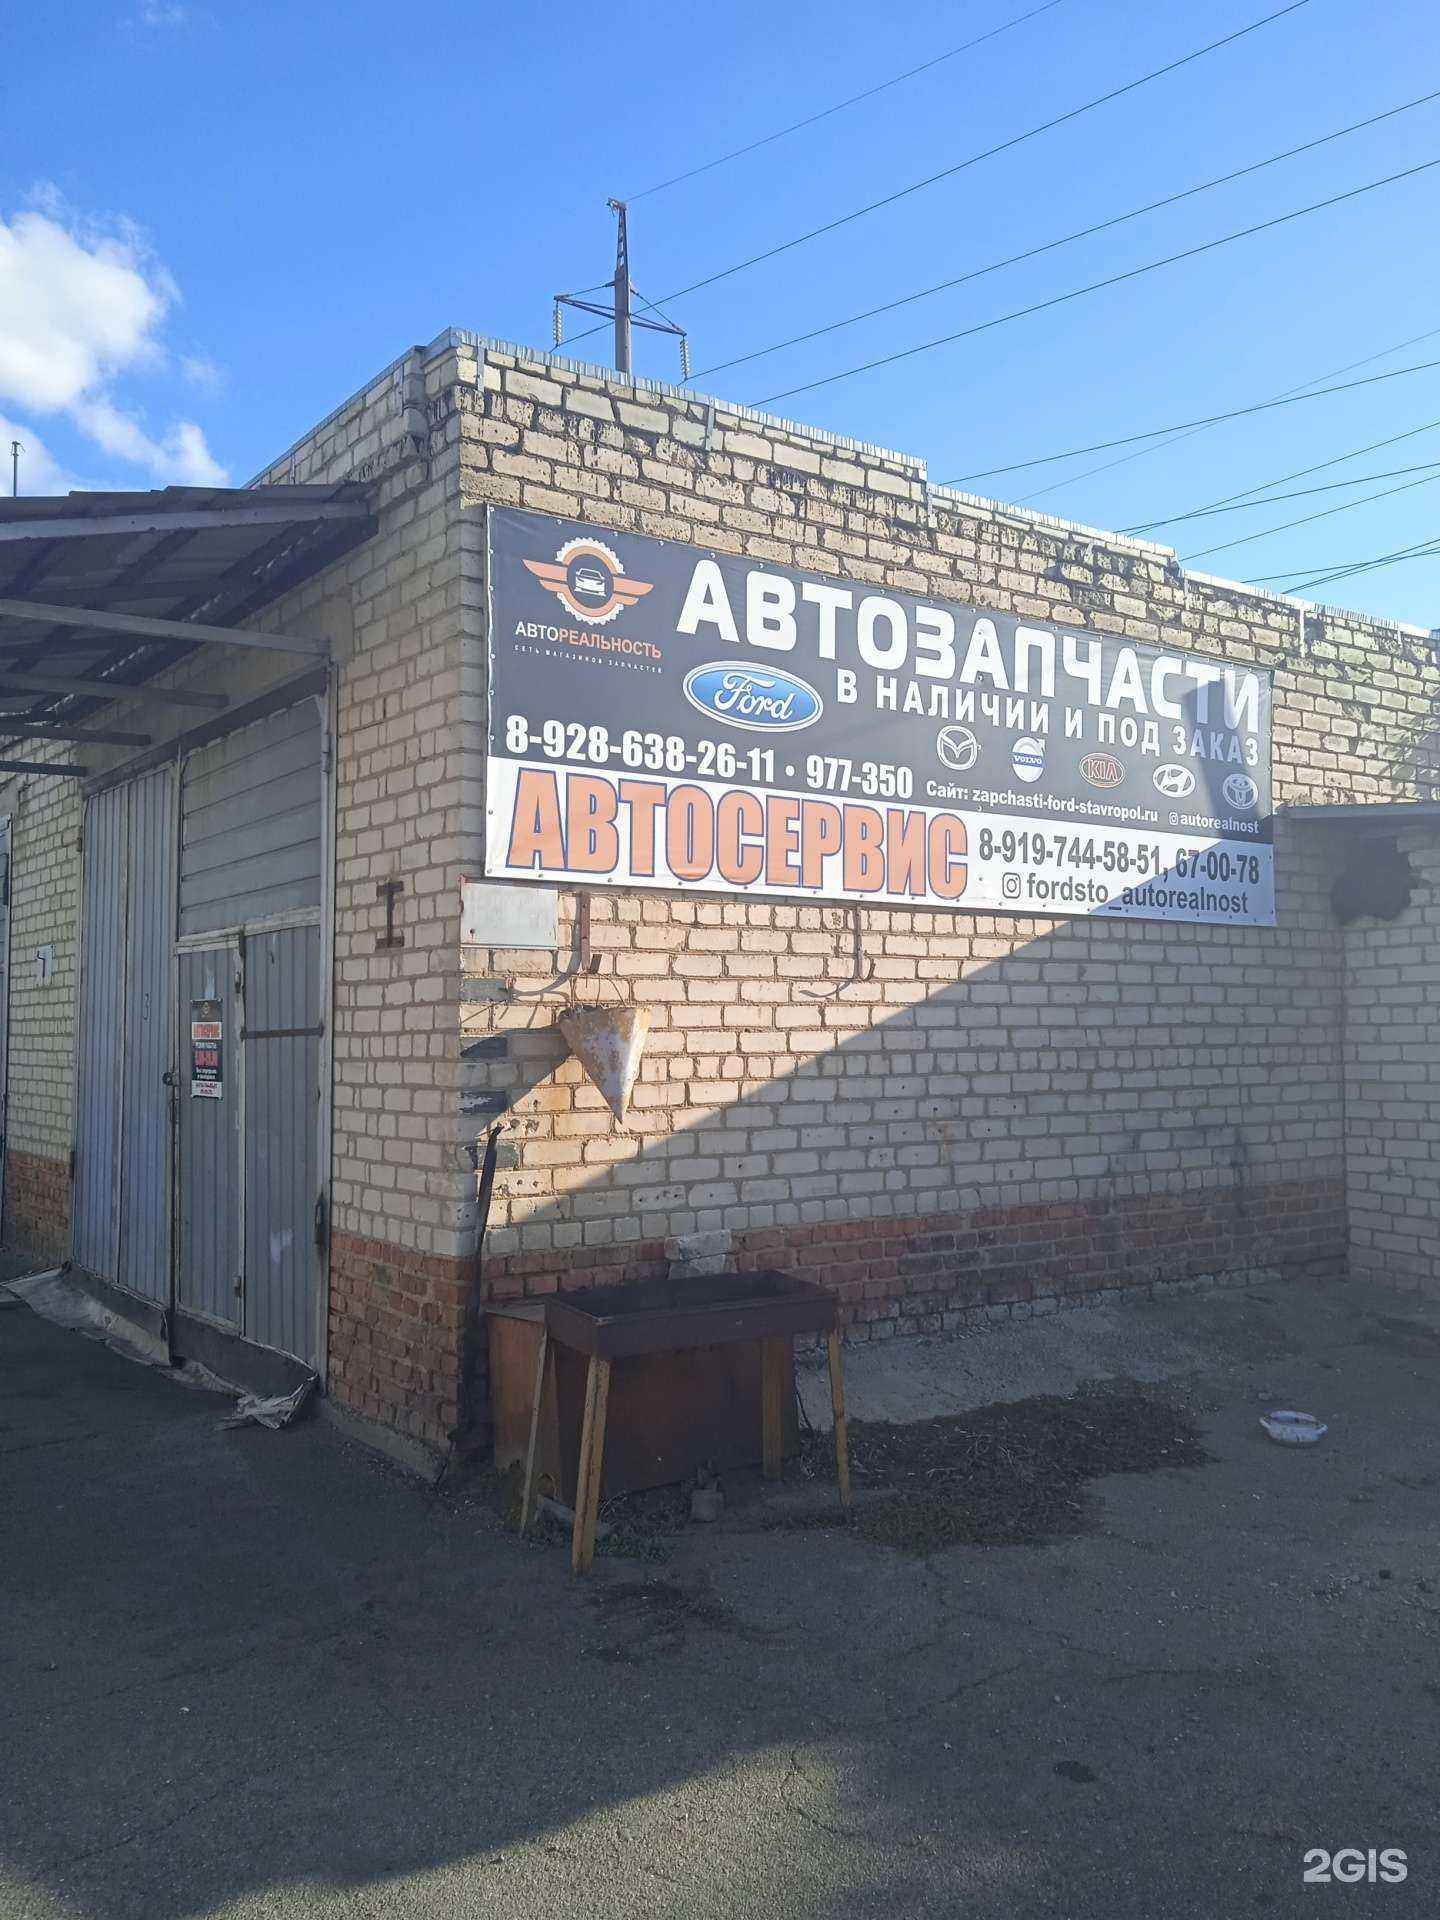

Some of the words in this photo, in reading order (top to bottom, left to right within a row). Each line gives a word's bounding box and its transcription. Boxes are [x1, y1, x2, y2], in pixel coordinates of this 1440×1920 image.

[515, 621, 662, 659] АВТОРЕАЛЬНОСТЬ
[676, 559, 1260, 734] АВТОЗАПЧАСТИ
[713, 671, 797, 721] Ford
[836, 667, 859, 704] В
[876, 674, 1049, 734] НАЛИЧИИ
[1065, 706, 1083, 740] И
[1098, 712, 1161, 757] ПОД
[1172, 725, 1260, 767] ЗАКАЗ
[506, 714, 775, 783] 8-928-638-26-11
[806, 754, 914, 799] 977-350
[1012, 755, 1044, 766] VOLVO
[1086, 758, 1119, 781] KIA
[926, 779, 969, 799] Сайт:
[971, 788, 1159, 823] zapchasti-ford-stavropol.ru
[505, 767, 969, 900] АВТОСЕРВИС
[979, 827, 1169, 882] 8-919-744-58-51,
[1175, 847, 1260, 884] 67-00-78
